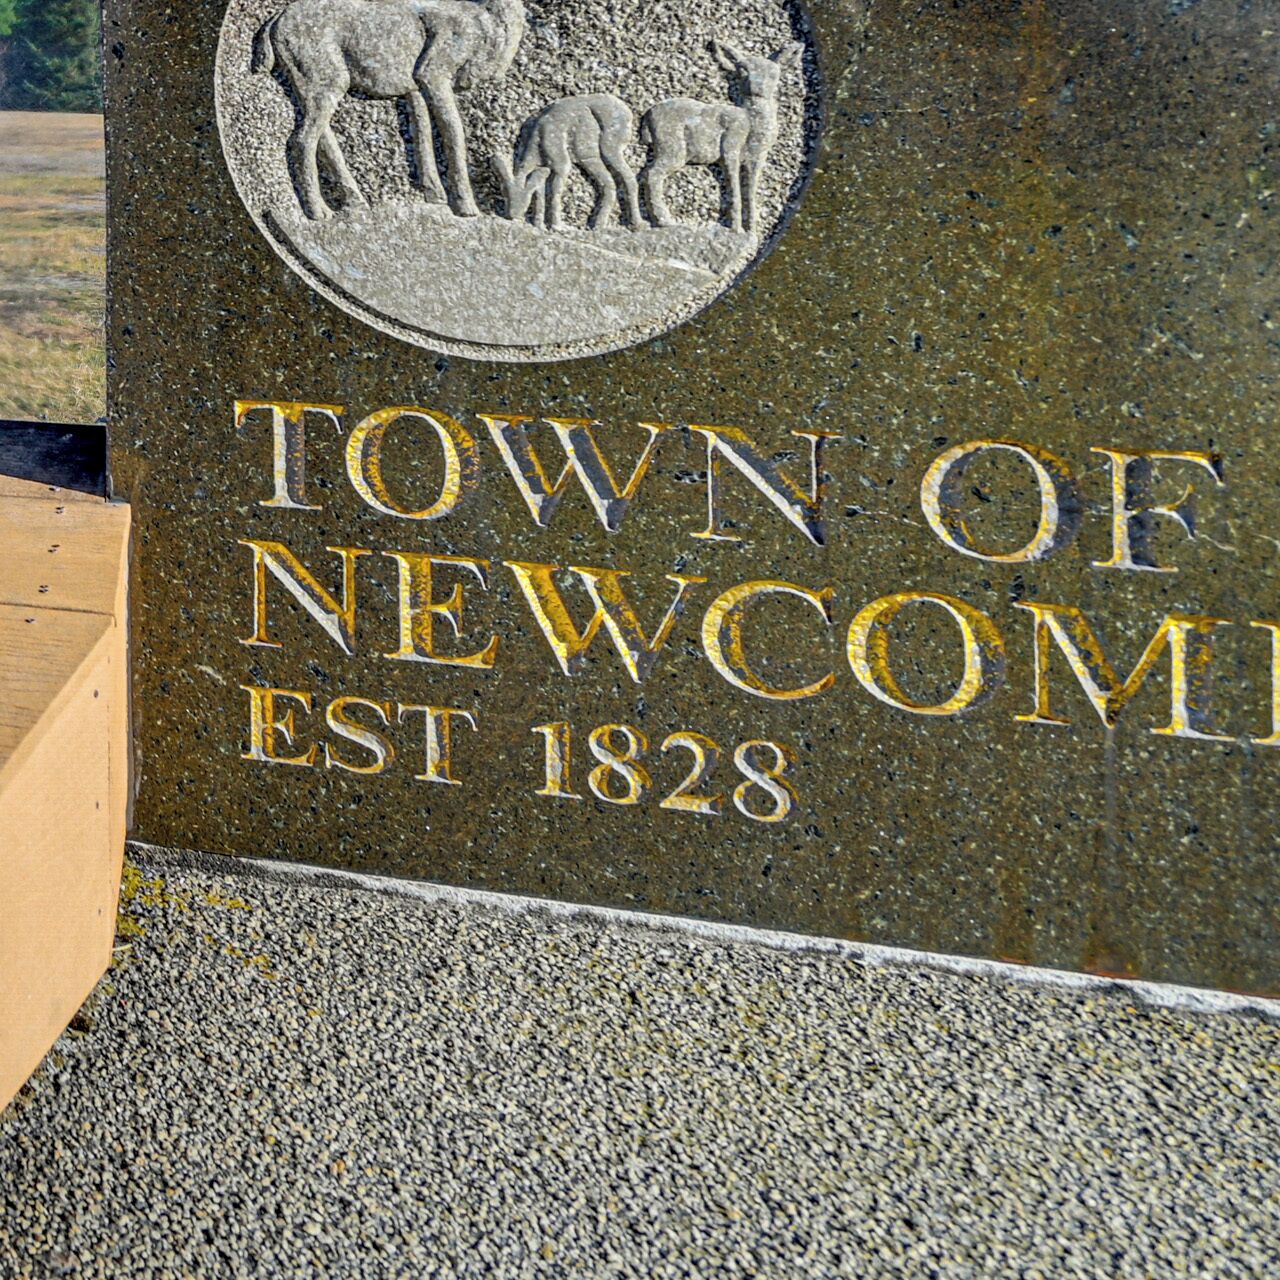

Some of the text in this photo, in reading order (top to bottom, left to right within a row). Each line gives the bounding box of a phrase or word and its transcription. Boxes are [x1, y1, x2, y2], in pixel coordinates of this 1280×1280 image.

[234, 399, 1226, 573] TOWN OF
[238, 683, 798, 823] EST 1828
